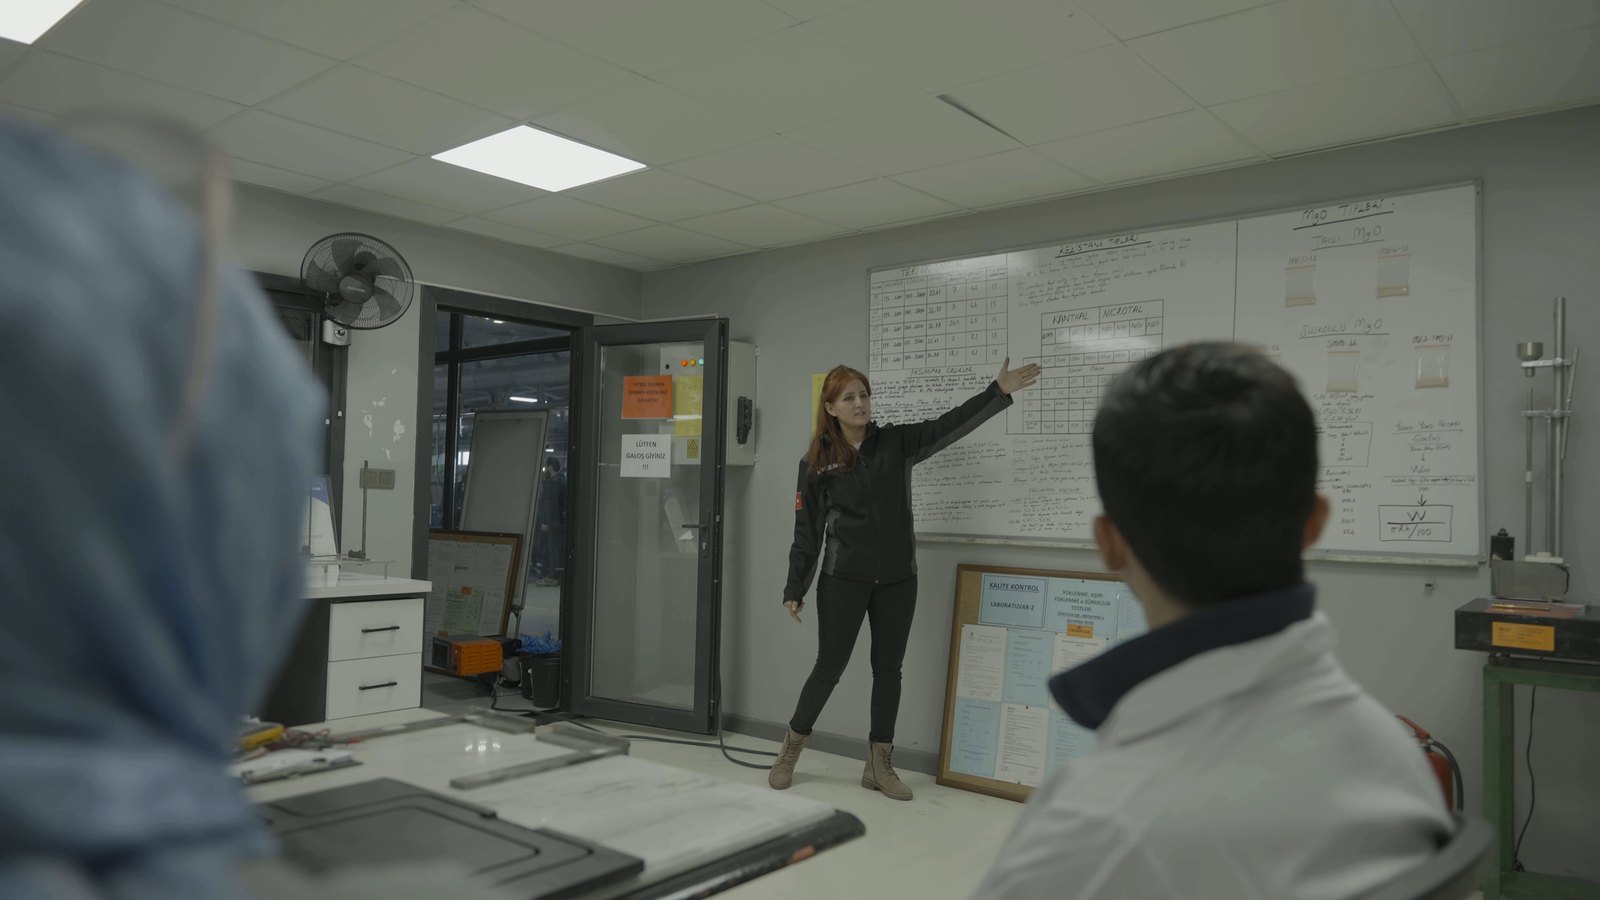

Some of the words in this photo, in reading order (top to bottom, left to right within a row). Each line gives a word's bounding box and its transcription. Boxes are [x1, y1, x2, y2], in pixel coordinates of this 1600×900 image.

[1353, 224, 1382, 242] MgO
[635, 439, 657, 448] LÜTFEN
[626, 452, 645, 461] GALOŞ
[989, 581, 1009, 591] KALİTE
[1010, 583, 1040, 592] KONTROL
[990, 602, 1035, 611] LABORATUVAR-2
